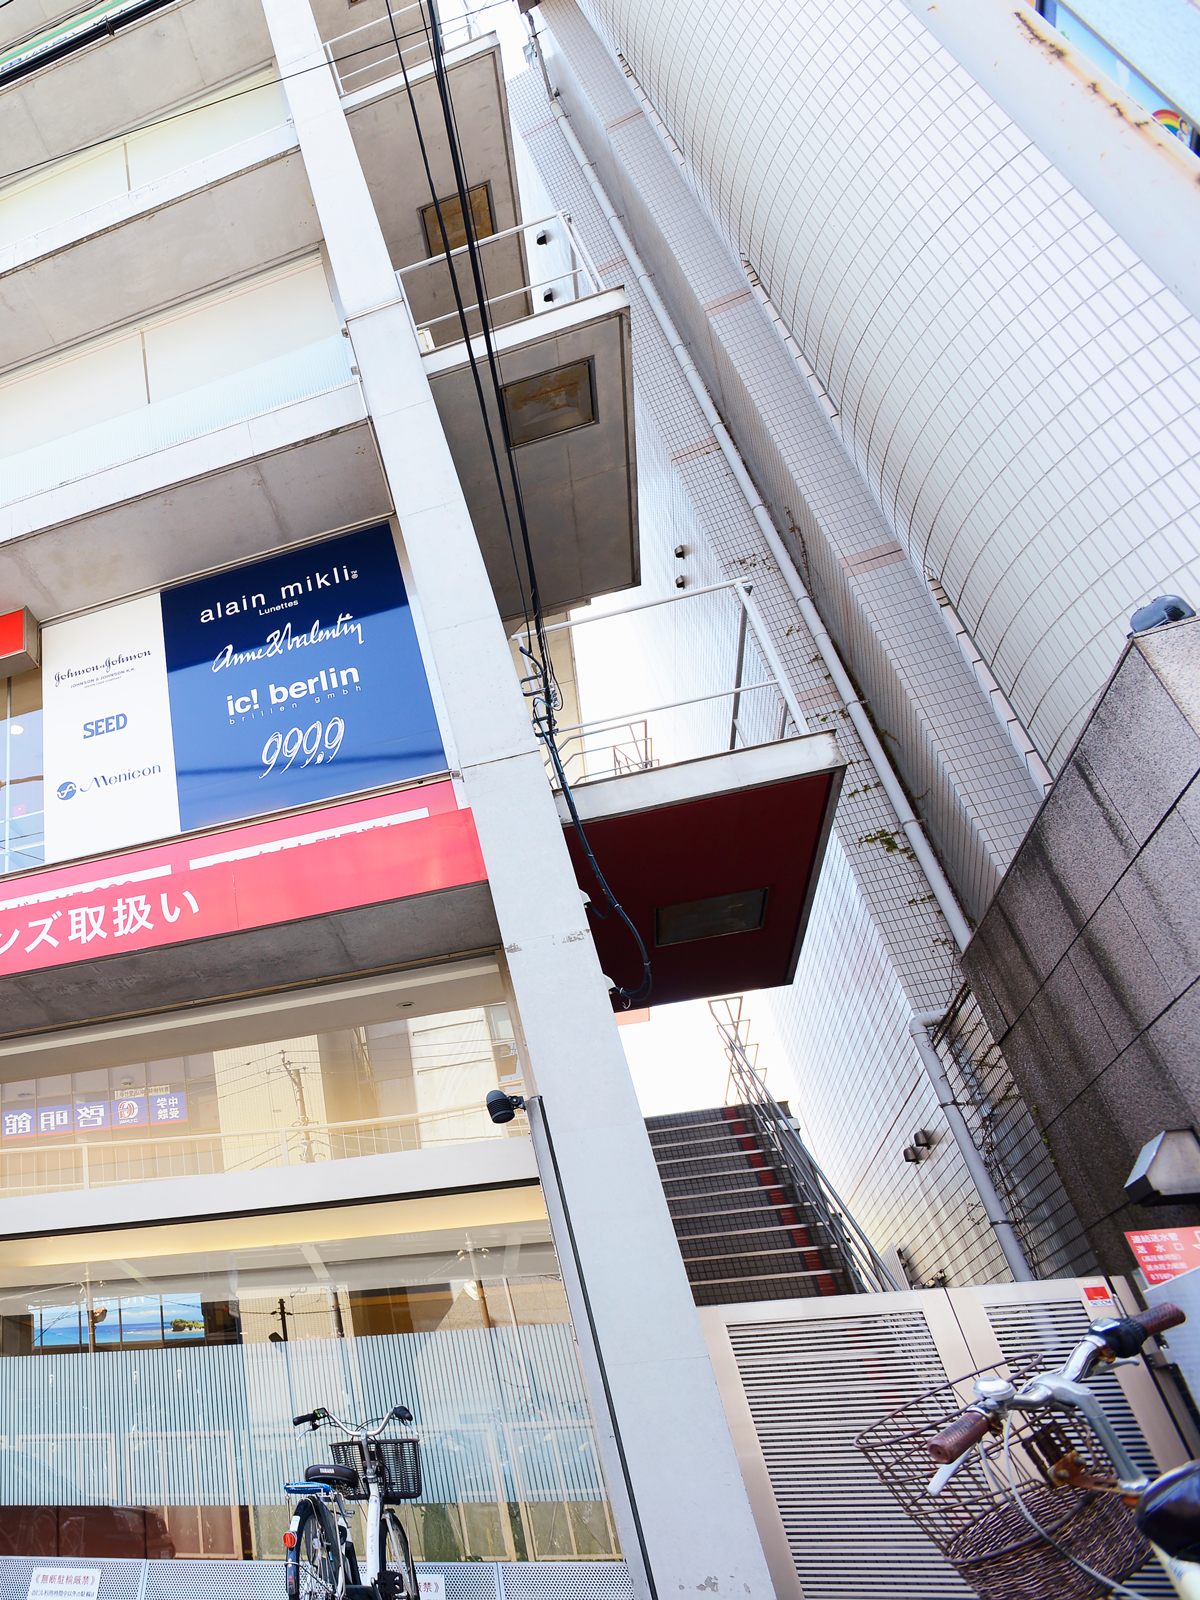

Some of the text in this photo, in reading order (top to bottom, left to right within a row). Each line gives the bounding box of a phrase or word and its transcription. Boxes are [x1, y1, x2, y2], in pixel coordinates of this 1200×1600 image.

[200, 565, 350, 623] alain mikli
[259, 599, 299, 616] Lunettes
[227, 664, 360, 716] ic! berlin
[83, 713, 128, 740] SEED
[80, 763, 161, 793] Menicon
